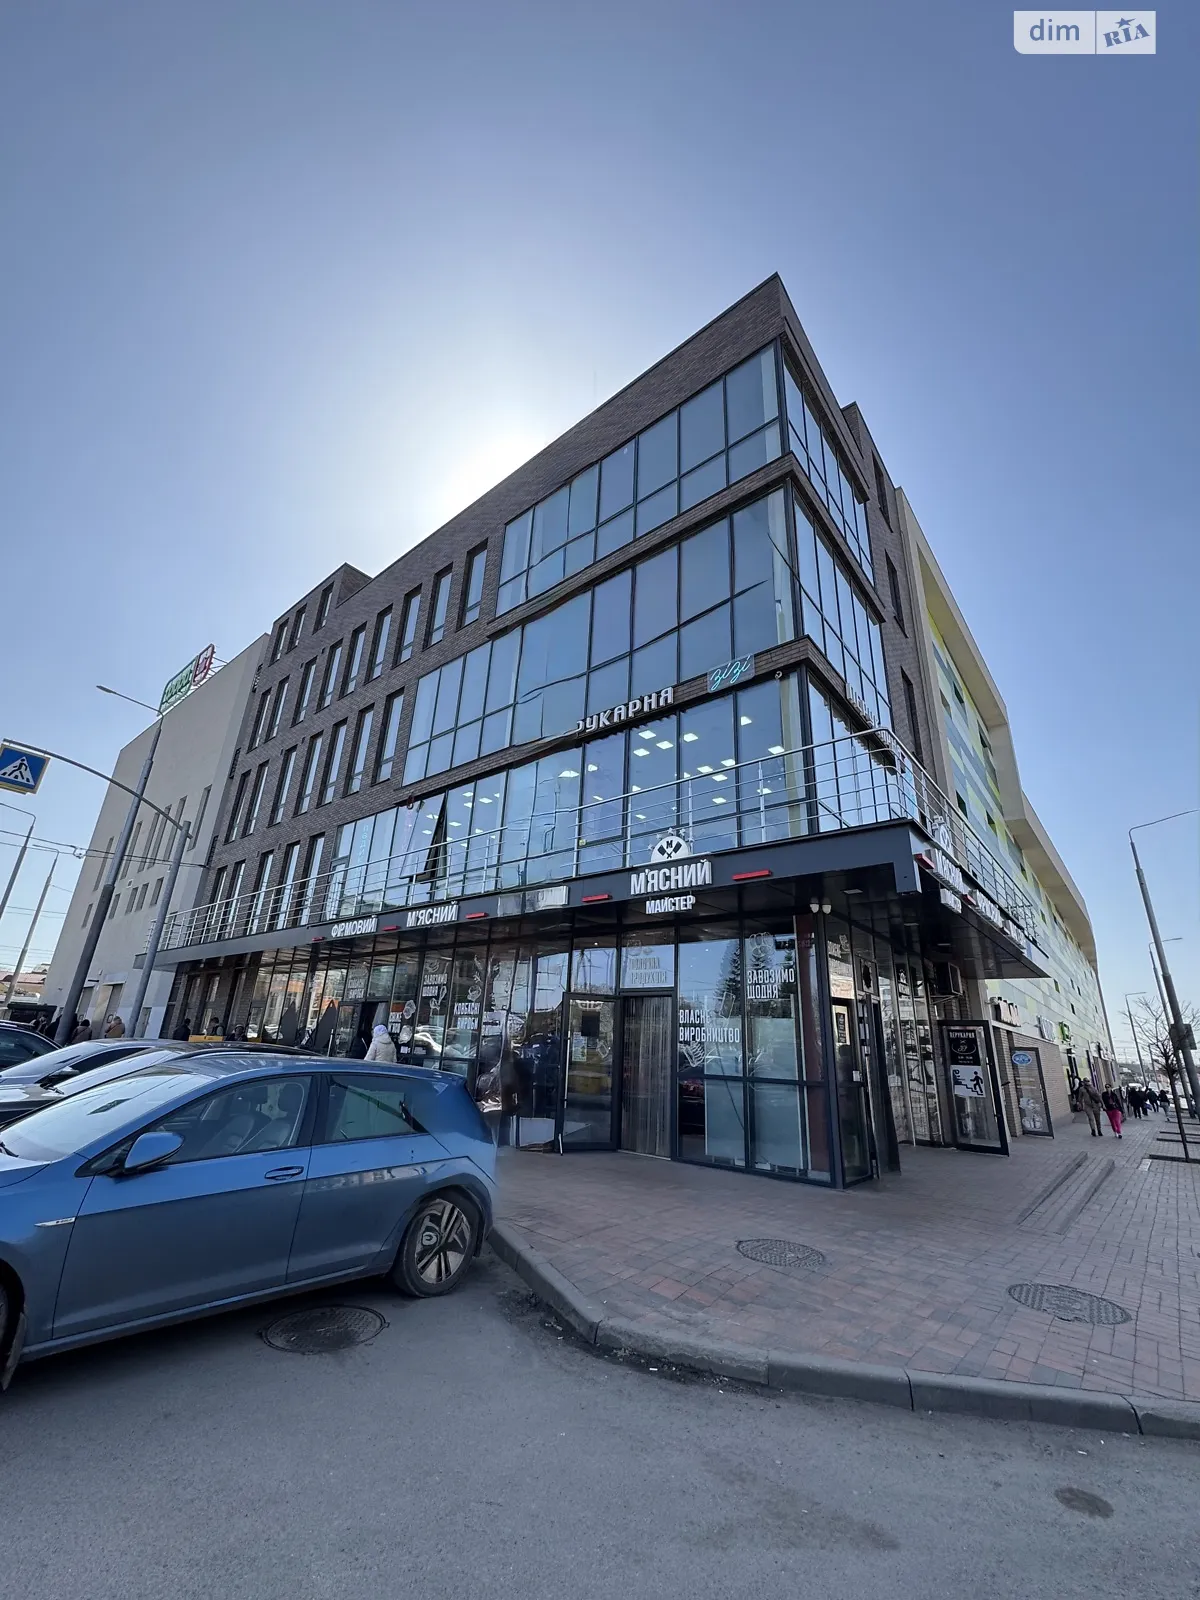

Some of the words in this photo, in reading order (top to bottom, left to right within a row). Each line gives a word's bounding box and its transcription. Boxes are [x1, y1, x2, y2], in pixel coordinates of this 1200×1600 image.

[630, 858, 712, 895] М'ЯСНИЙ
[645, 895, 696, 914] МАЙСТЕР
[406, 900, 459, 928] М'ЯСНИЙ
[747, 968, 795, 984] ЗАВОЗИМО
[747, 985, 779, 999] ЩОДНЯ
[679, 1009, 711, 1024] ВЛАСНЕ
[679, 1026, 740, 1043] ВИРОБНИЦТВО
